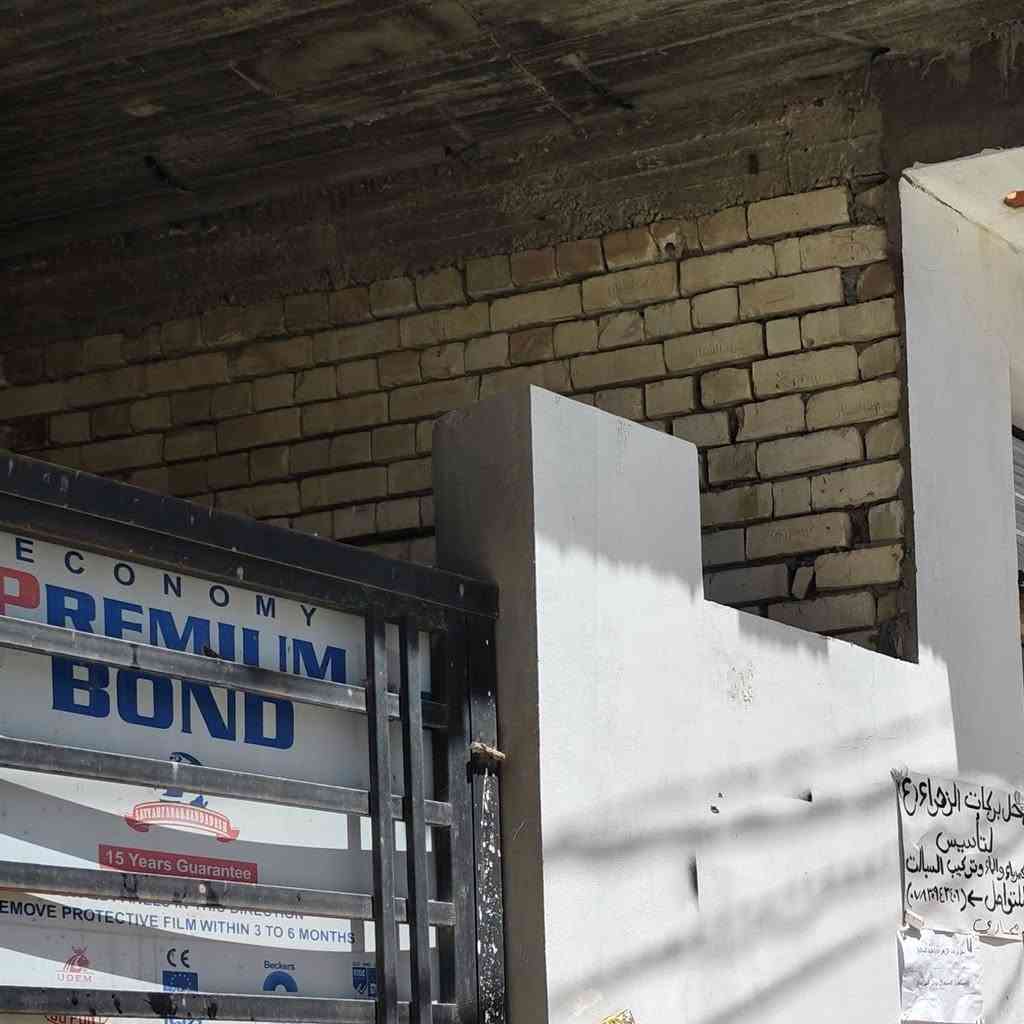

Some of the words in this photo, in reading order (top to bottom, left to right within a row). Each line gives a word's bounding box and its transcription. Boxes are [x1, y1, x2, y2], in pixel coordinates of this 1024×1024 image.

[15, 537, 318, 627] ECONOMY
[51, 657, 295, 751] BOND
[106, 849, 124, 866] 15
[128, 852, 173, 872] Years
[176, 859, 252, 880] Guarantee
[62, 906, 159, 929] PROTECTIVE
[163, 915, 197, 932] FILM
[200, 919, 250, 936] WITHIN
[254, 924, 263, 936] 3
[267, 925, 284, 938] TO
[287, 926, 296, 939] 6
[299, 929, 356, 945] MONTHS
[166, 948, 191, 968] CE
[57, 973, 93, 983] UDEM
